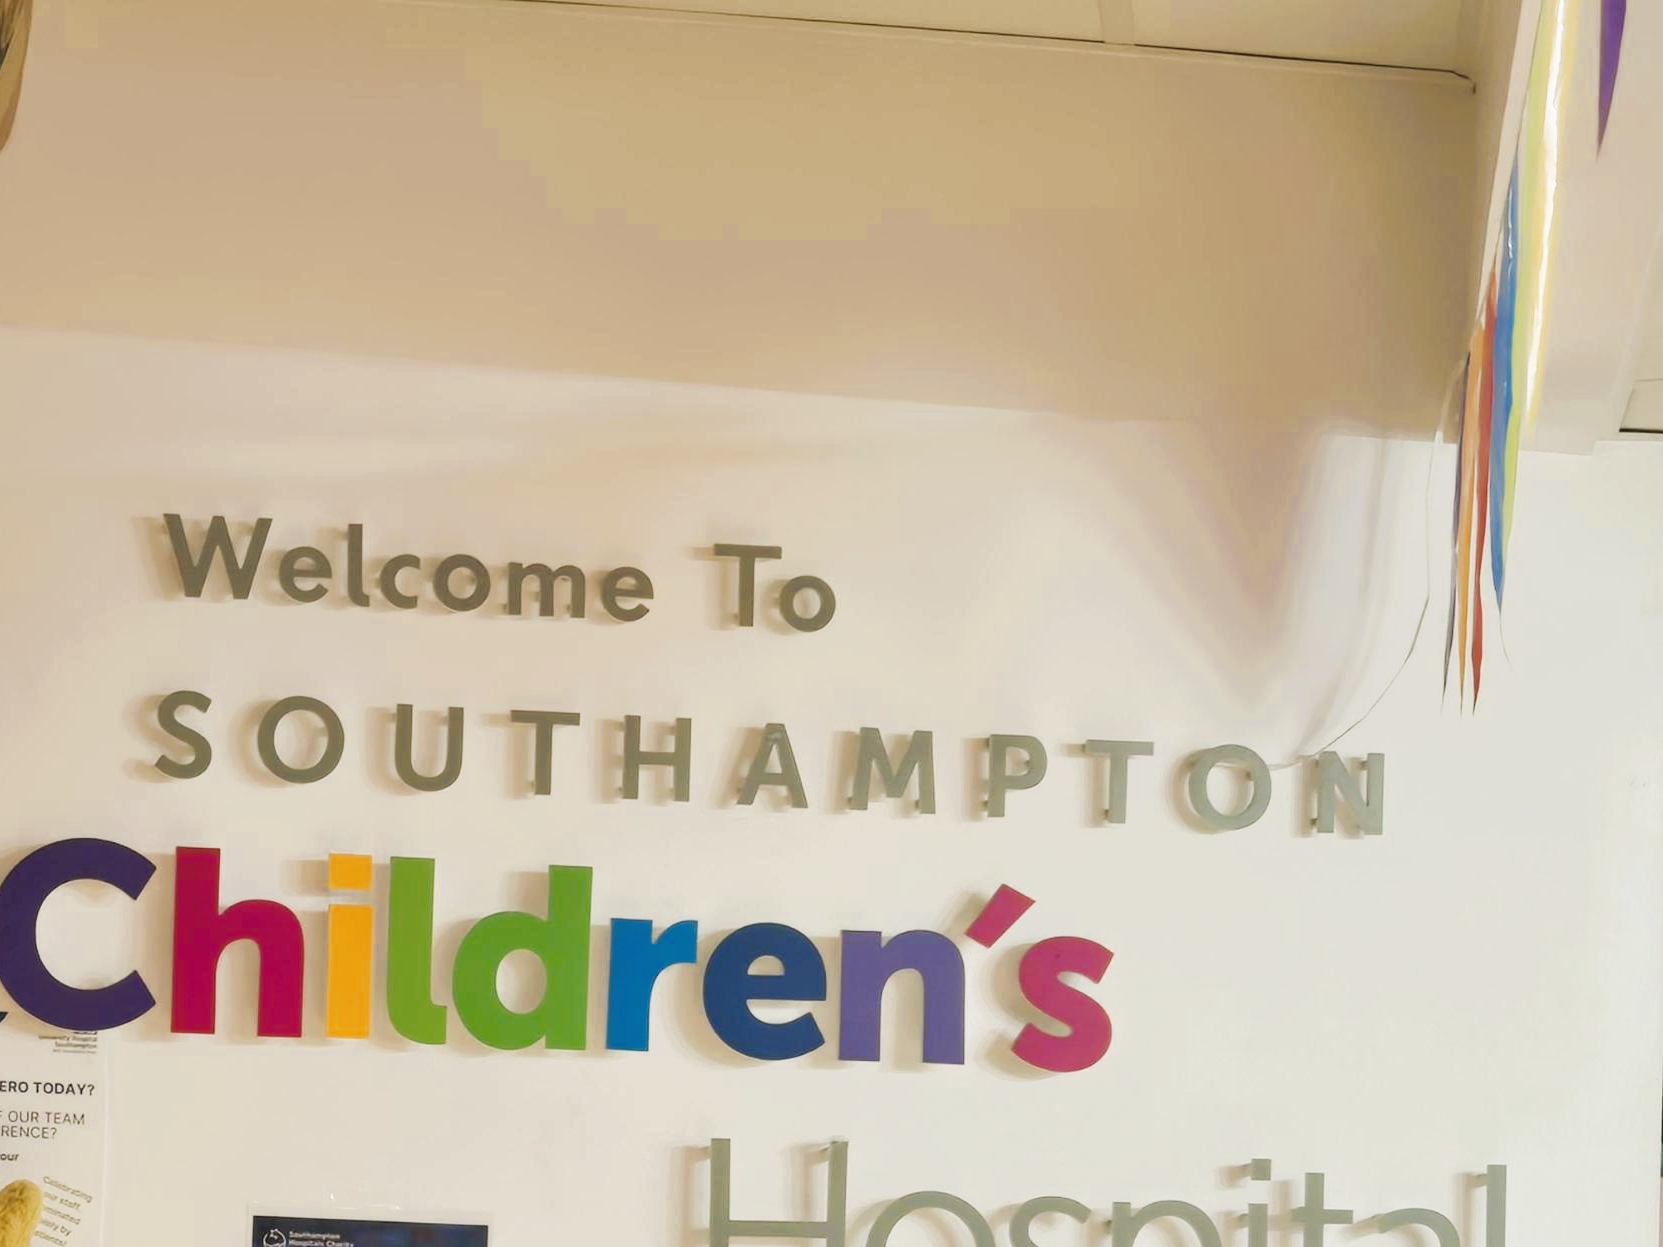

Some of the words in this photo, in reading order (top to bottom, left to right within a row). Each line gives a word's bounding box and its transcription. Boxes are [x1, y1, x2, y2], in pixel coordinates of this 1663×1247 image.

[162, 513, 654, 622] Welcome
[713, 543, 837, 632] To
[154, 689, 1385, 835] SOUTHAMPTON
[8, 1110, 39, 1123] OUR
[45, 1111, 86, 1125] TEAM
[33, 1081, 95, 1096] TODAY?
